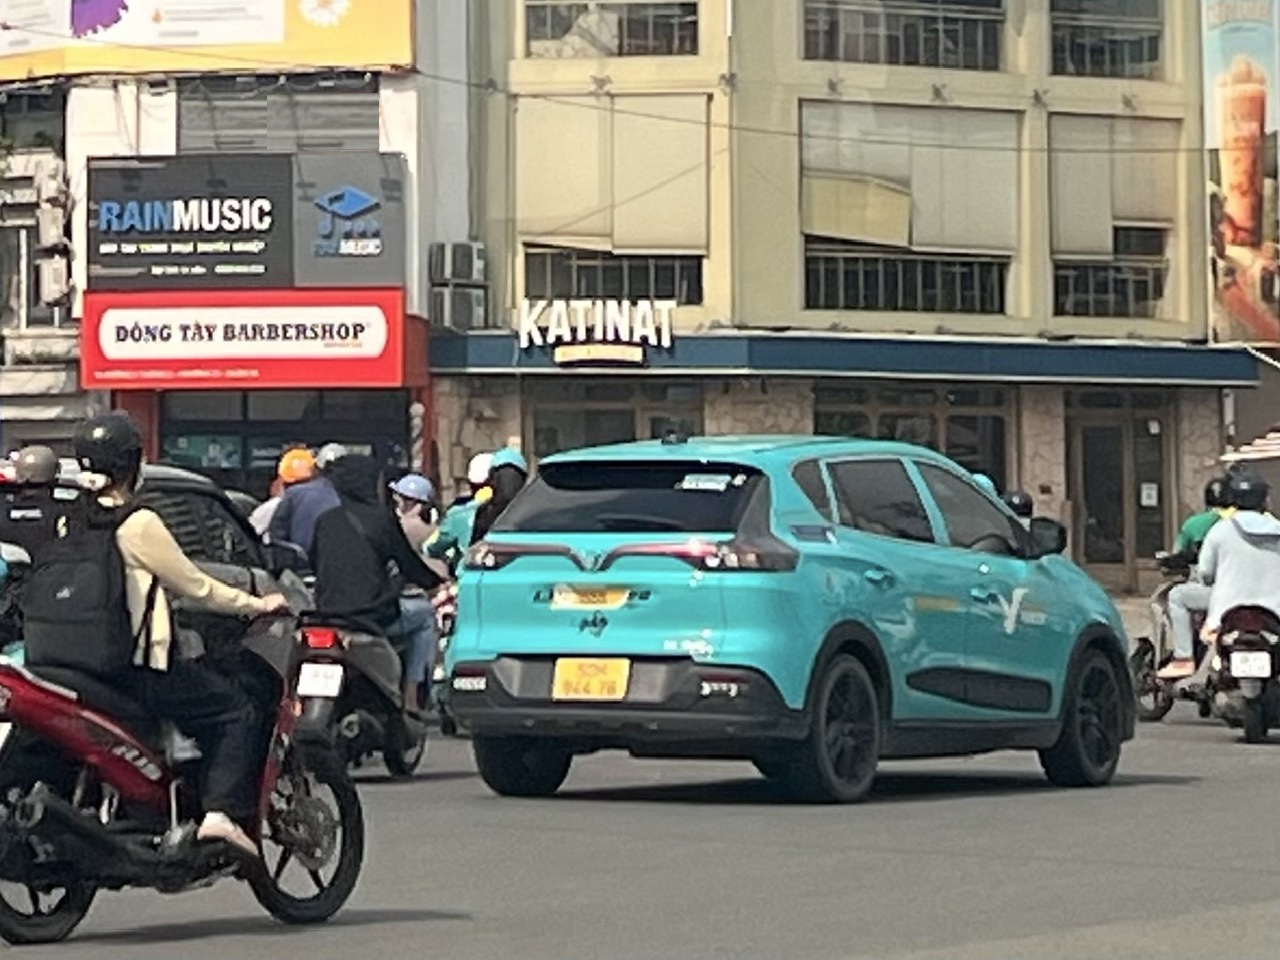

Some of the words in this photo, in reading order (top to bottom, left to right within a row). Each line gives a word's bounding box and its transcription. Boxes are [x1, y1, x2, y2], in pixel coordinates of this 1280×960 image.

[99, 198, 273, 233] RAINMUSIC
[222, 322, 366, 342] BARBERSHOP
[520, 298, 678, 349] KATINAT
